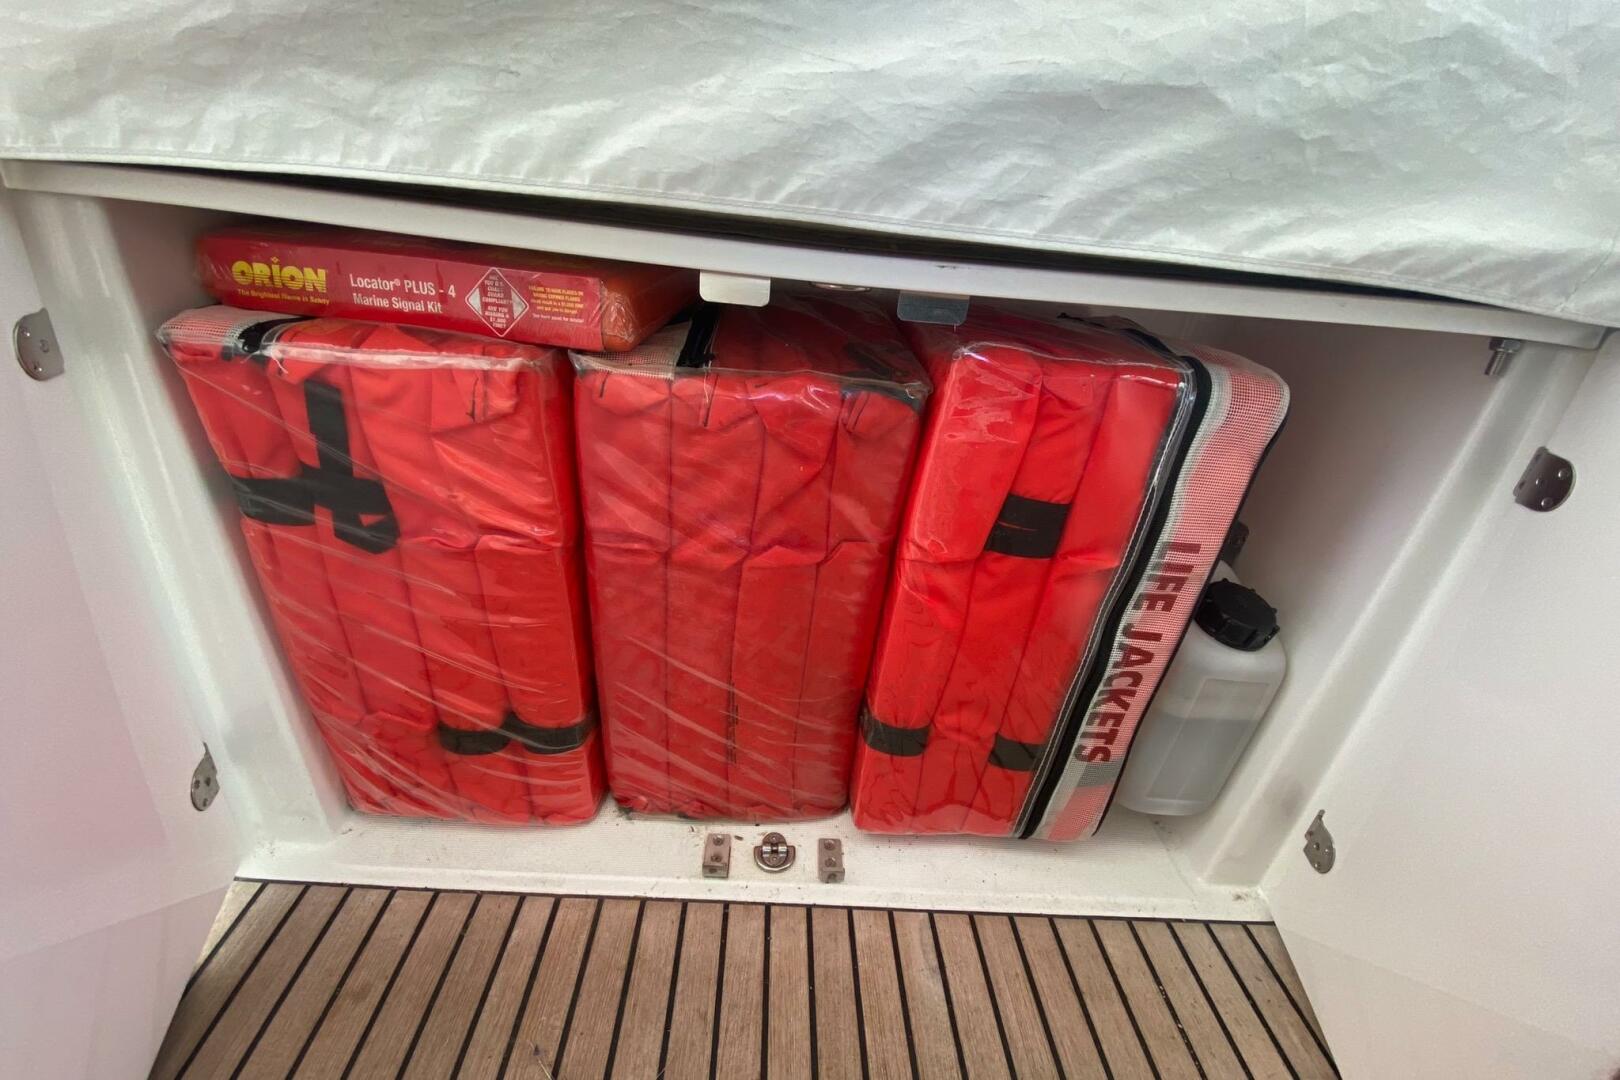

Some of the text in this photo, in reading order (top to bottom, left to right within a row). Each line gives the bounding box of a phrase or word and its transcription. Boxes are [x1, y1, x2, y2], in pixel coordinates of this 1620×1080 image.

[352, 293, 443, 314] Marine Signal Kit
[403, 279, 436, 296] PLUS
[447, 284, 457, 298] 4
[1132, 541, 1202, 613] LIFE
[1073, 622, 1164, 764] JACKETS
